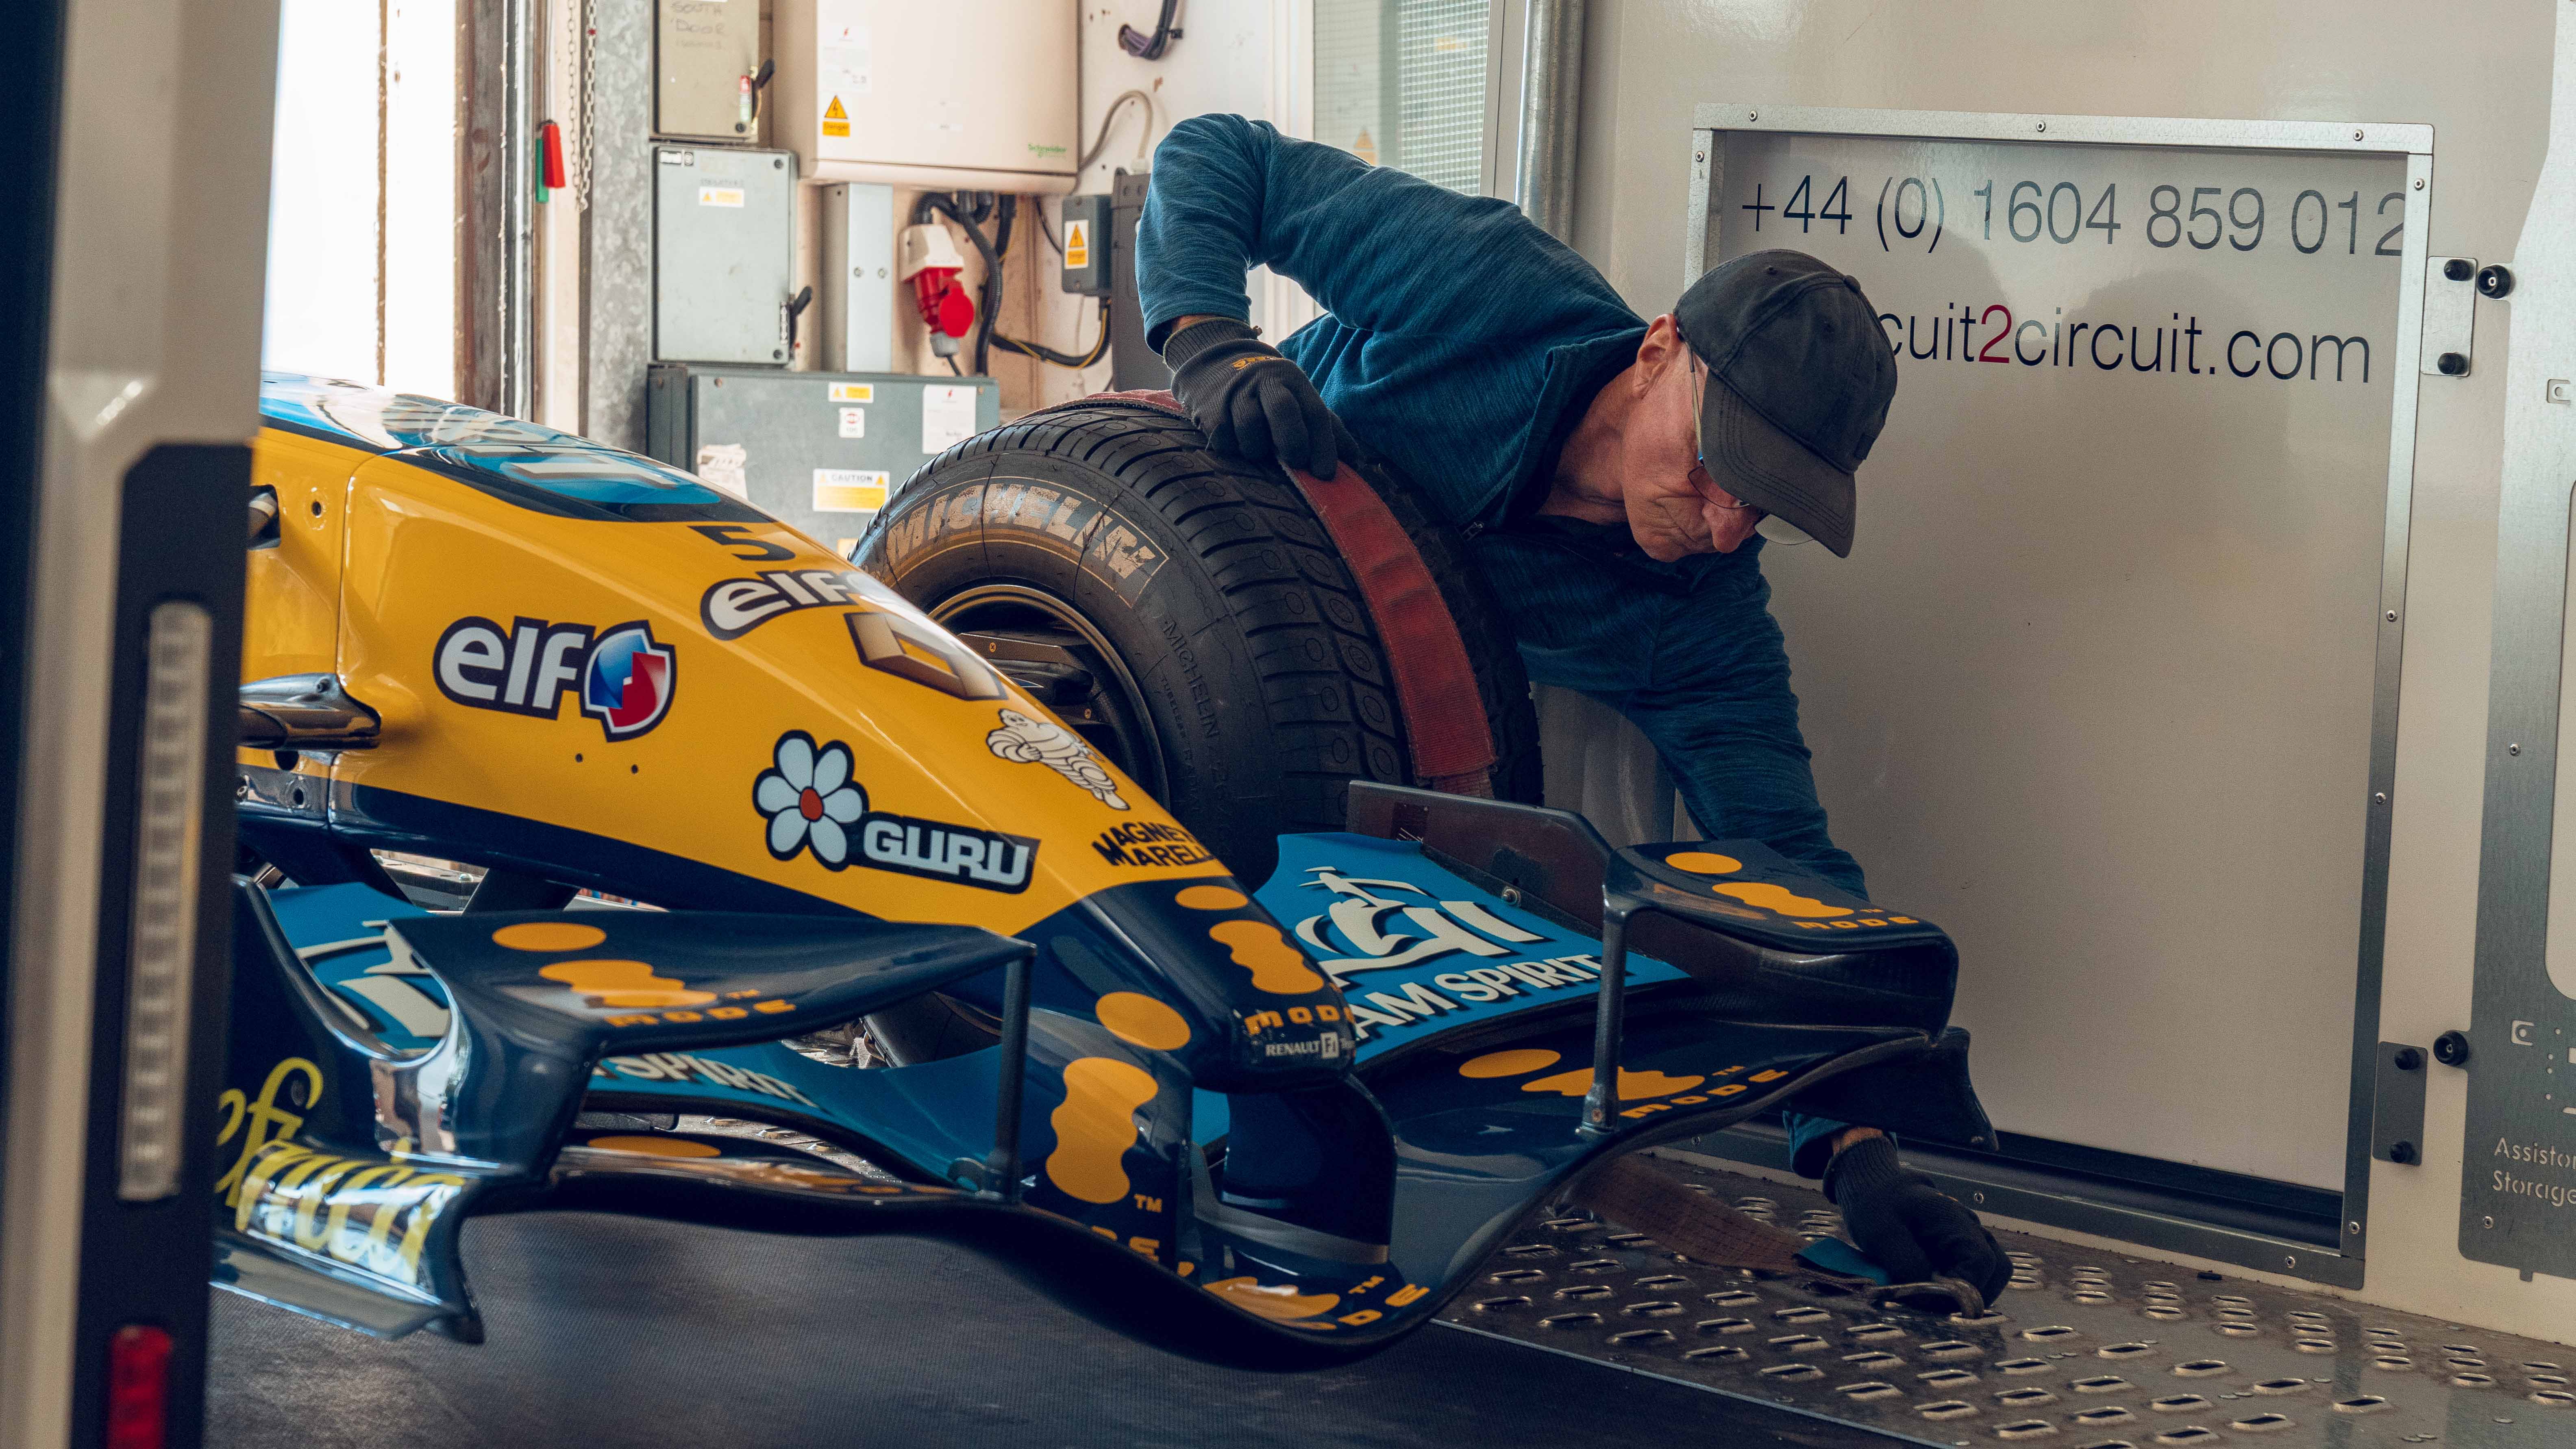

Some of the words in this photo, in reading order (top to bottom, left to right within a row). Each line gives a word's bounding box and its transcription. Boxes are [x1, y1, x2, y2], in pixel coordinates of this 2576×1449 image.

[1742, 175, 1852, 235] +44
[1877, 176, 1944, 253] (0)
[1974, 180, 2121, 245] 1604
[2147, 185, 2265, 251] 859
[2291, 189, 2406, 256] 012
[1878, 302, 2369, 383] cuit2circuit.com
[688, 525, 796, 561] 5
[886, 483, 1160, 580] MICHELIN
[708, 570, 851, 632] elf
[439, 626, 586, 710] elf
[1163, 621, 1221, 738] MICHELIN
[863, 819, 1029, 886] GURU
[1348, 982, 1458, 1041] AM
[1434, 953, 1602, 1001] SPIRIT
[1266, 1040, 1320, 1057] RENAULT
